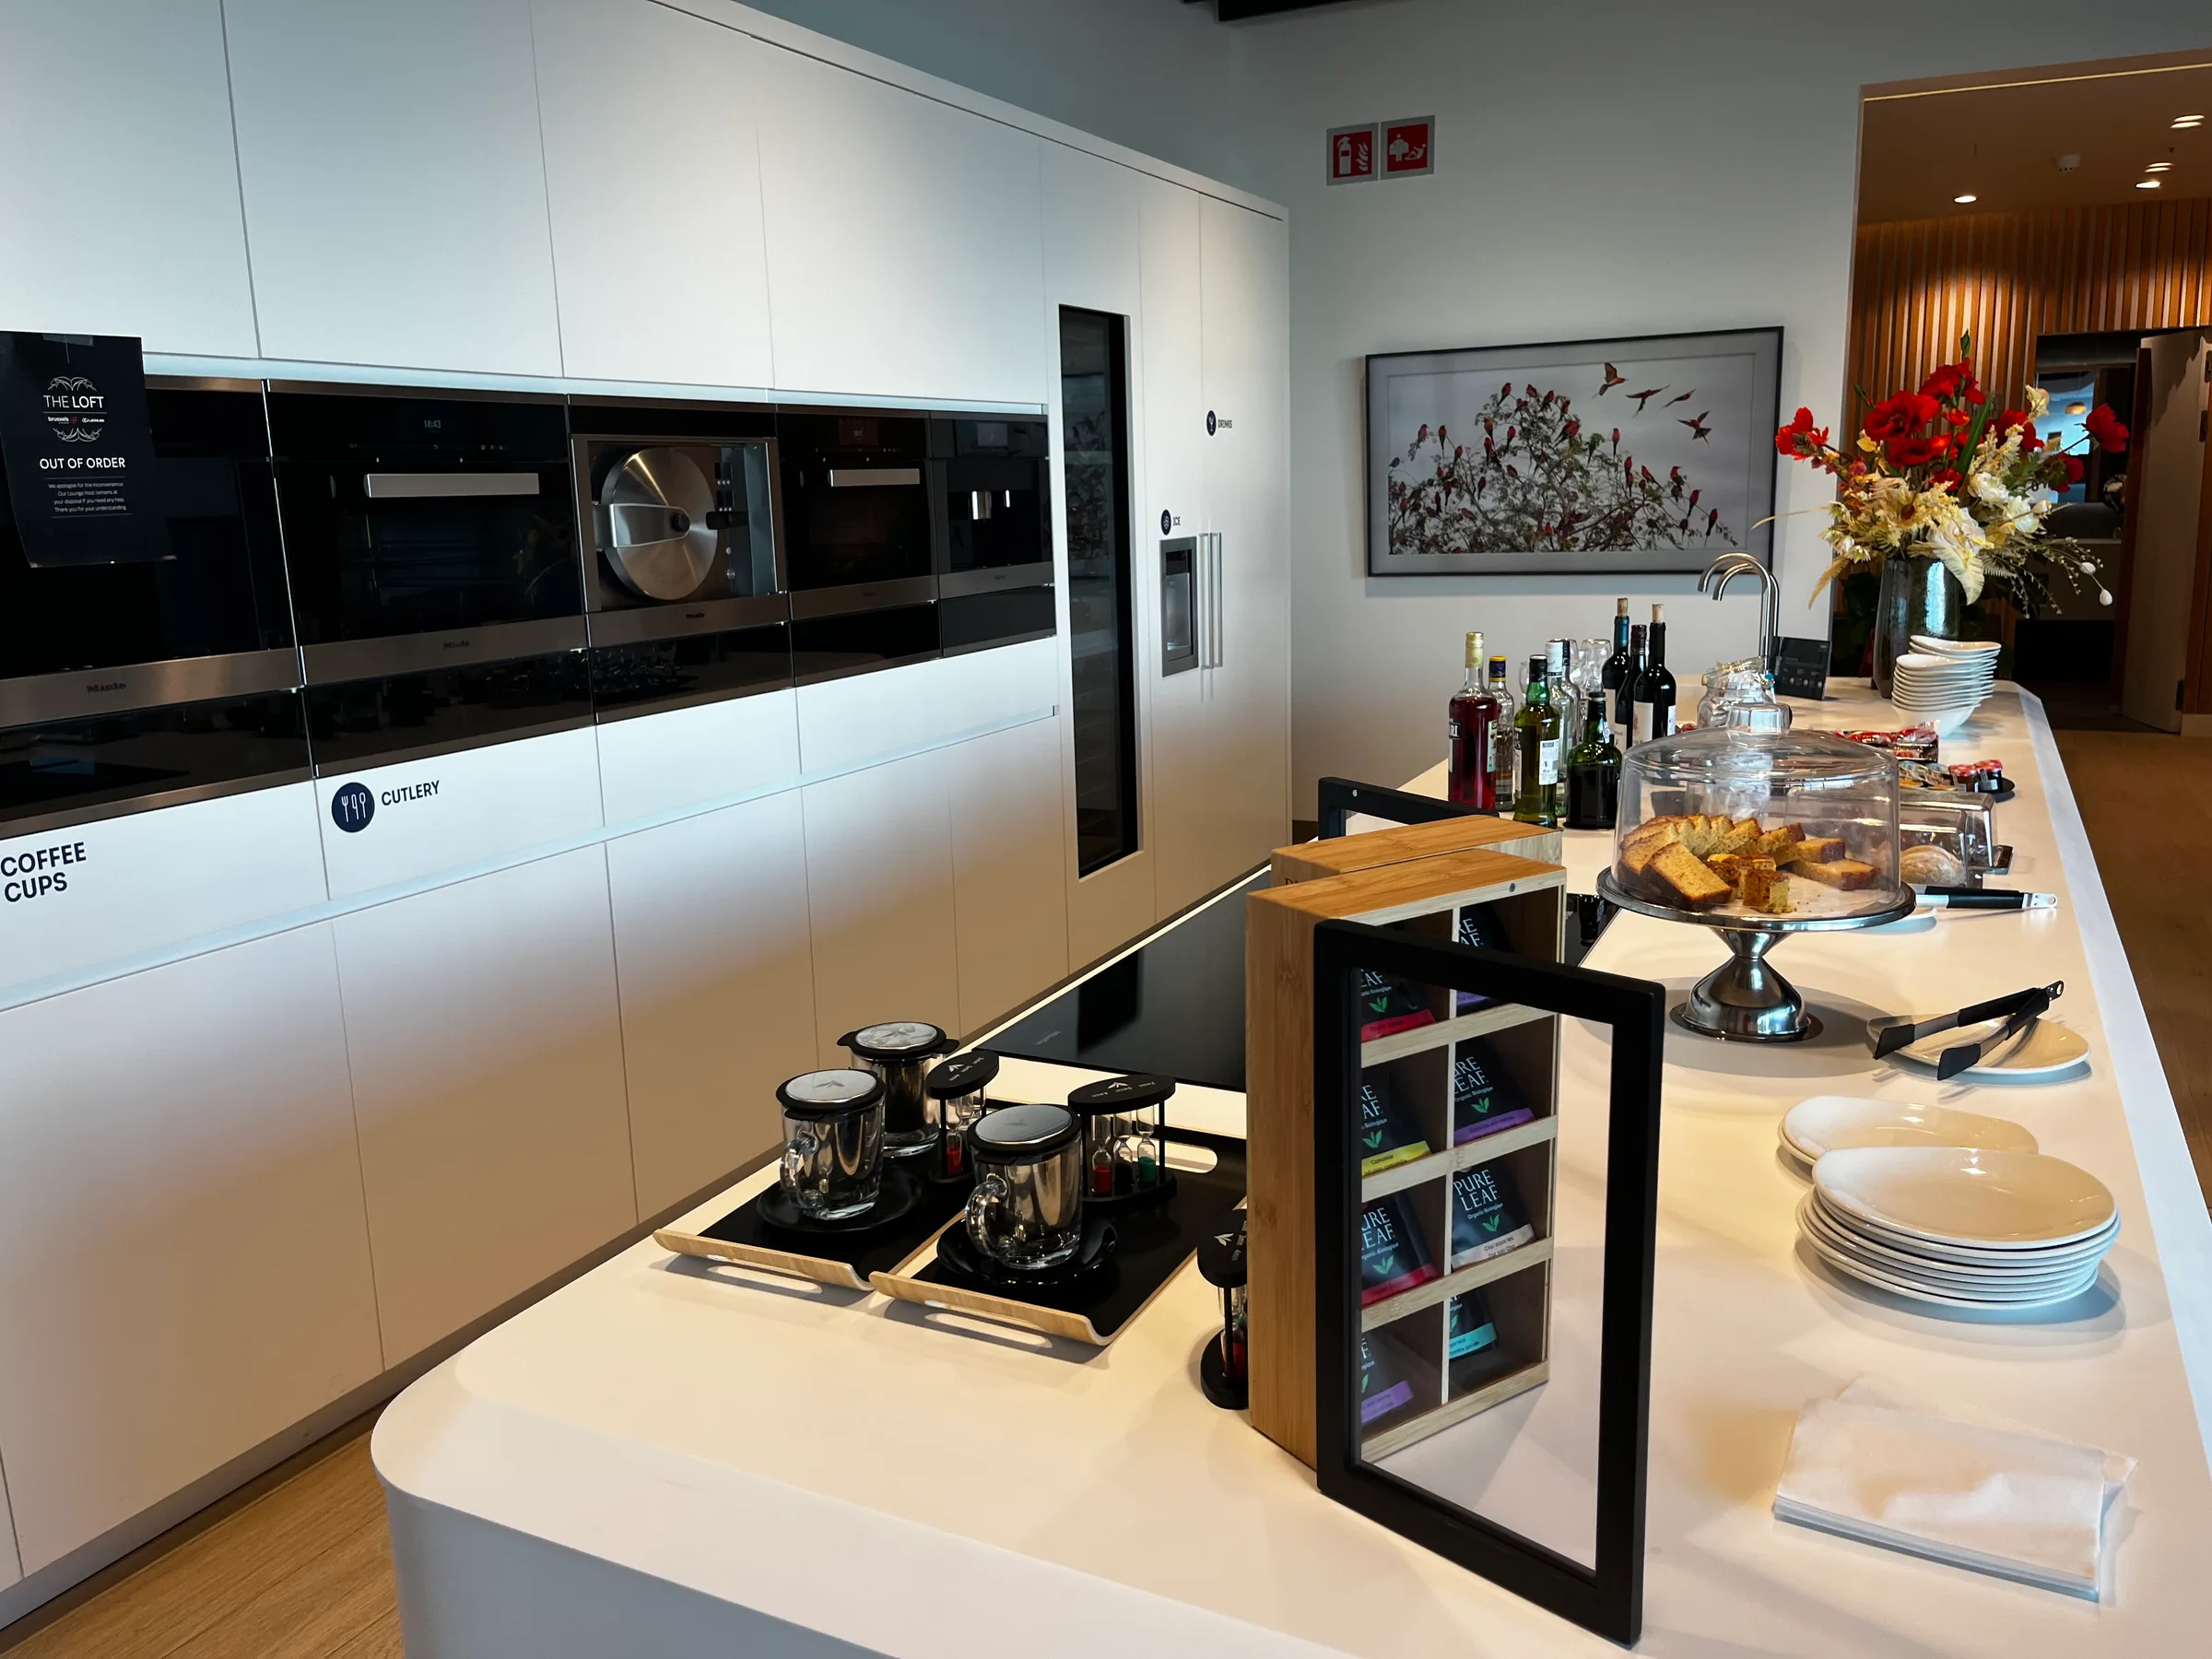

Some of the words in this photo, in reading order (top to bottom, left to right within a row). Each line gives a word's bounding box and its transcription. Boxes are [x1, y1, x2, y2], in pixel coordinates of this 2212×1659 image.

[43, 395, 69, 407] THE
[72, 395, 104, 408] LOFT
[40, 458, 65, 469] OUT
[67, 458, 83, 468] OF
[86, 457, 125, 468] ORDER
[1172, 517, 1181, 525] ICE
[381, 780, 441, 807] CUTLERY
[0, 841, 88, 877] COFFEE
[4, 872, 68, 903] CUPS
[1454, 1069, 1487, 1094] EAF
[1362, 1100, 1381, 1120] AF
[1453, 1169, 1494, 1195] PURE
[1461, 1184, 1498, 1211] LEAF
[1361, 1223, 1394, 1248] EAF
